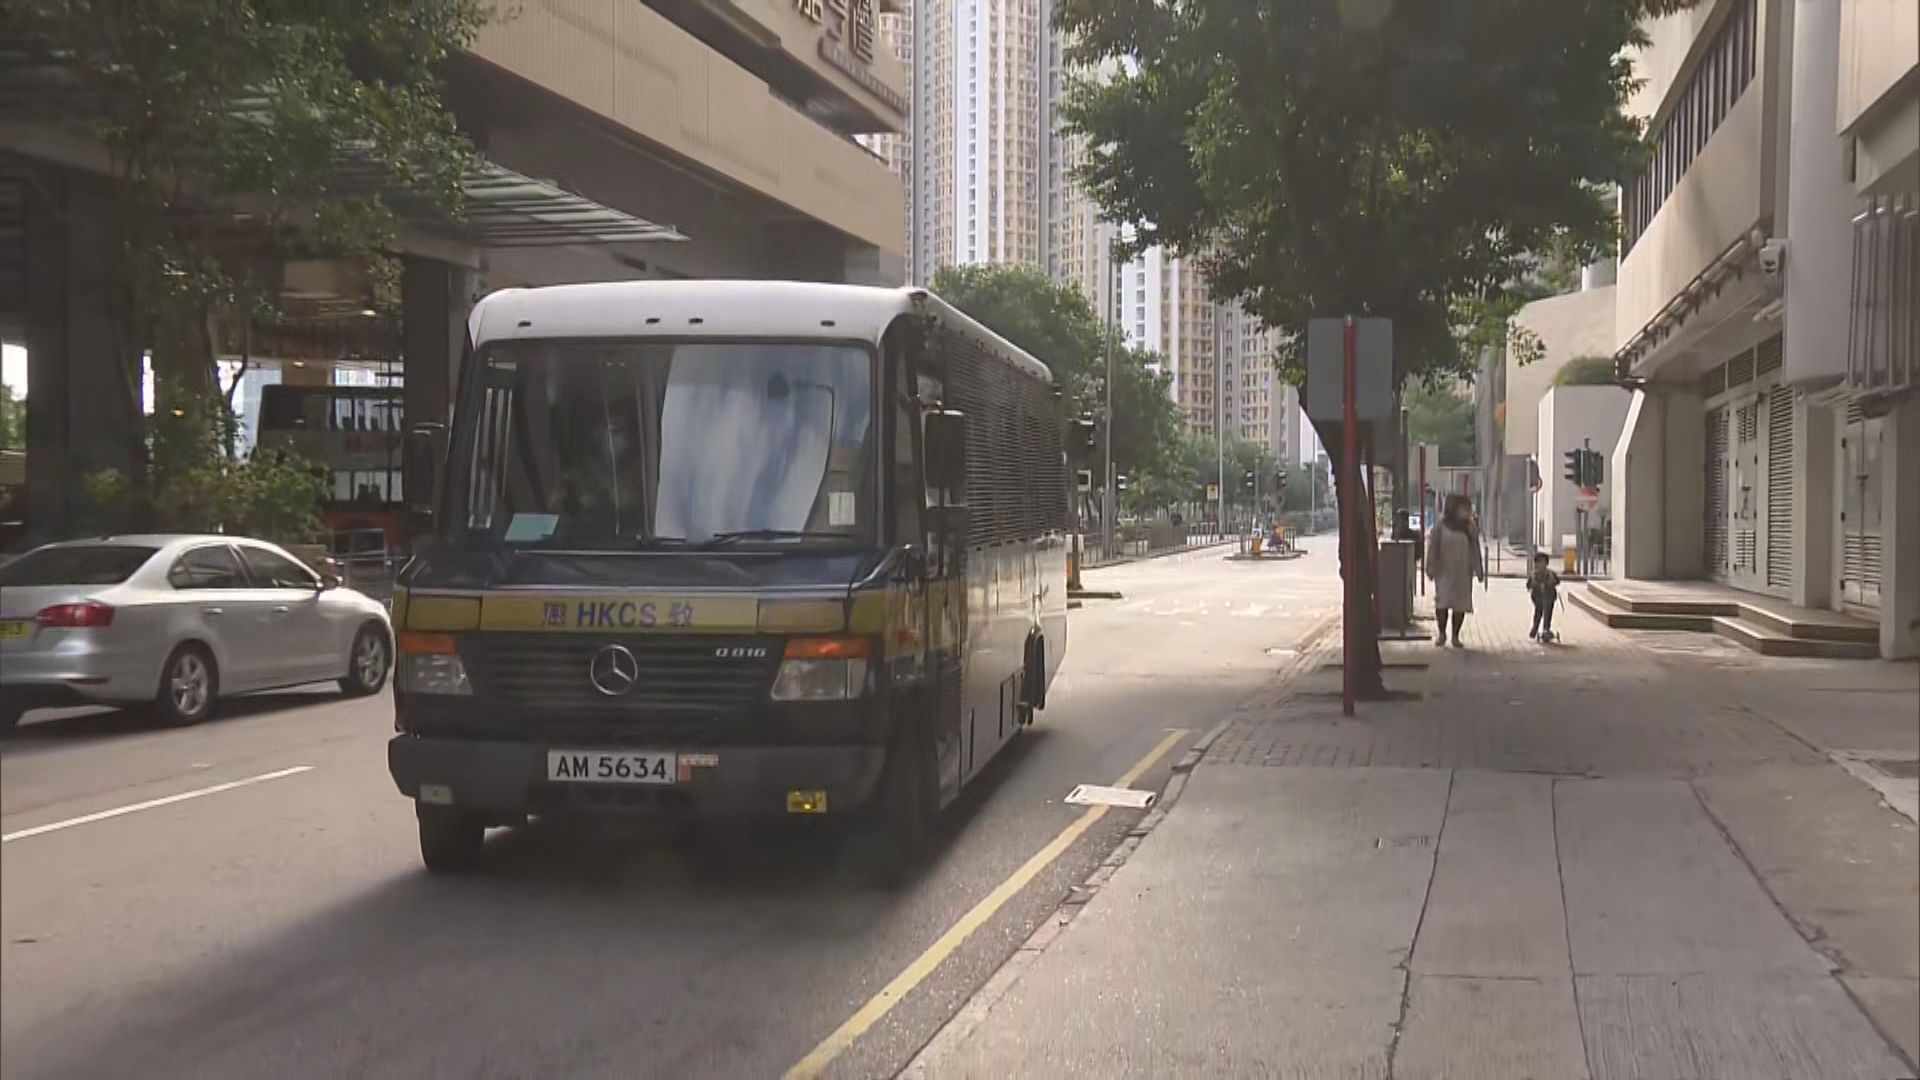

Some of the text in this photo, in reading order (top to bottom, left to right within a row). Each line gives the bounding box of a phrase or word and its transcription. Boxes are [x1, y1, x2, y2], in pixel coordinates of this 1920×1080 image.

[577, 602, 656, 627] HKCS
[556, 755, 589, 778] AM
[597, 756, 667, 780] 5634
